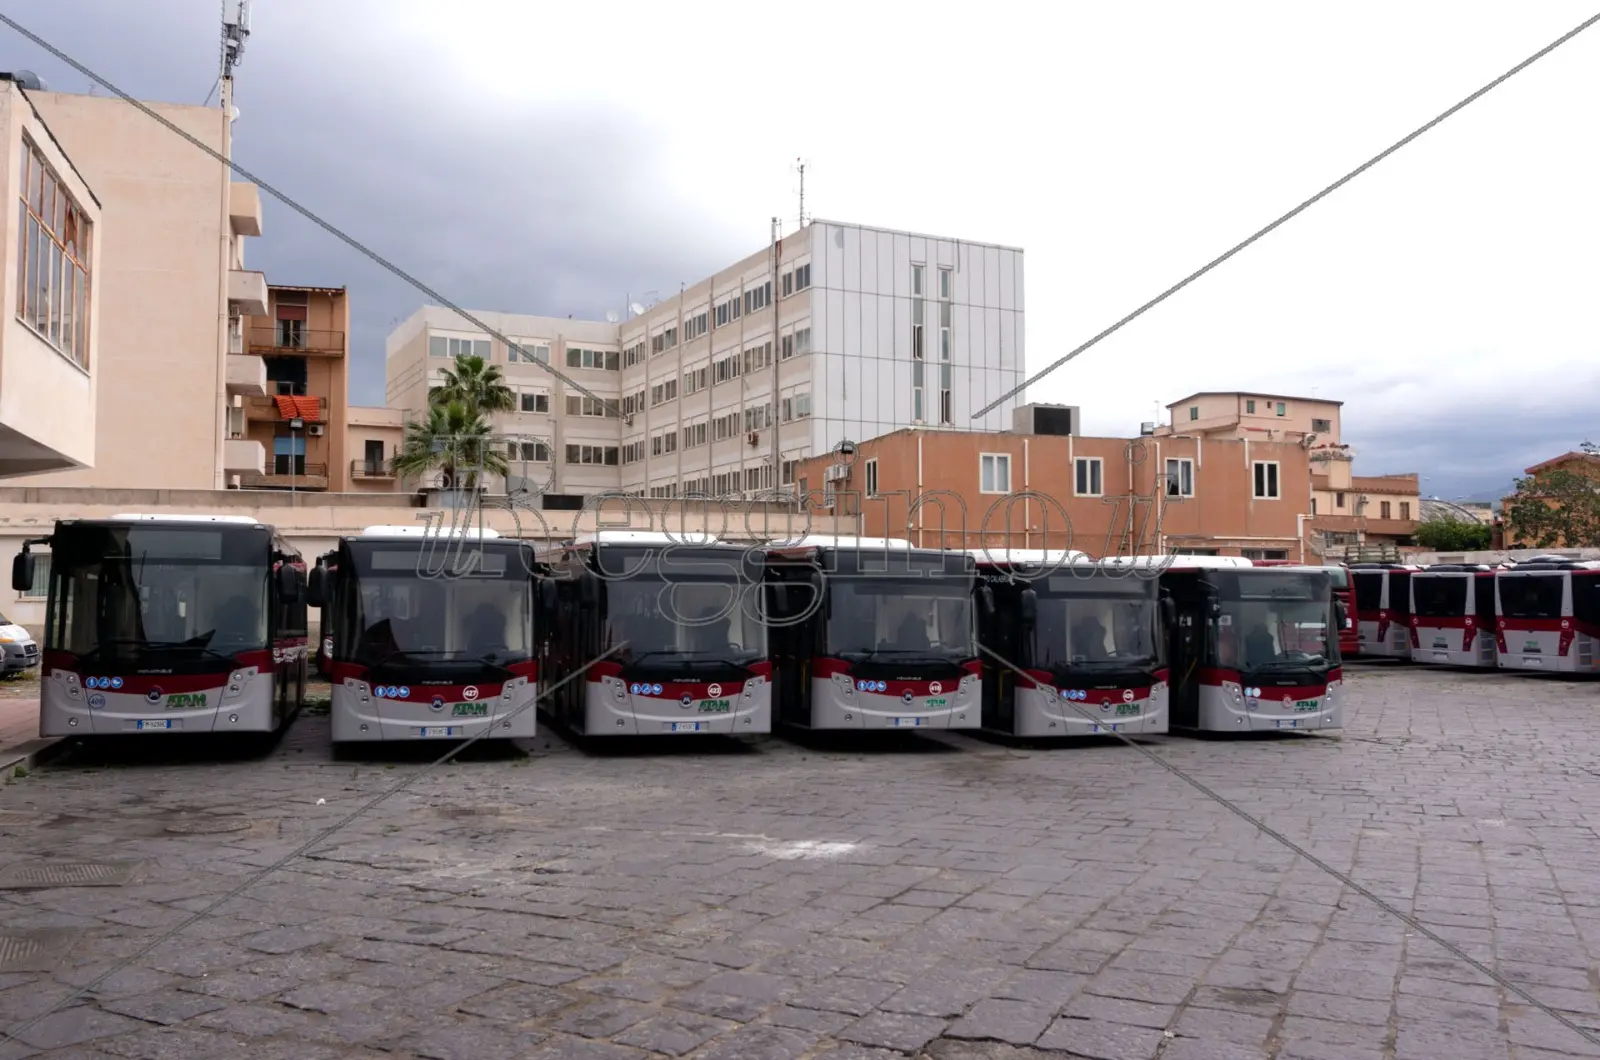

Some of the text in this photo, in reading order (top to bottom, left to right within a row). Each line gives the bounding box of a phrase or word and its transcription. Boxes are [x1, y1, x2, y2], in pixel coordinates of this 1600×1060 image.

[166, 693, 207, 708] ATAM
[698, 699, 730, 712] ATAM
[452, 702, 488, 715] ATAM
